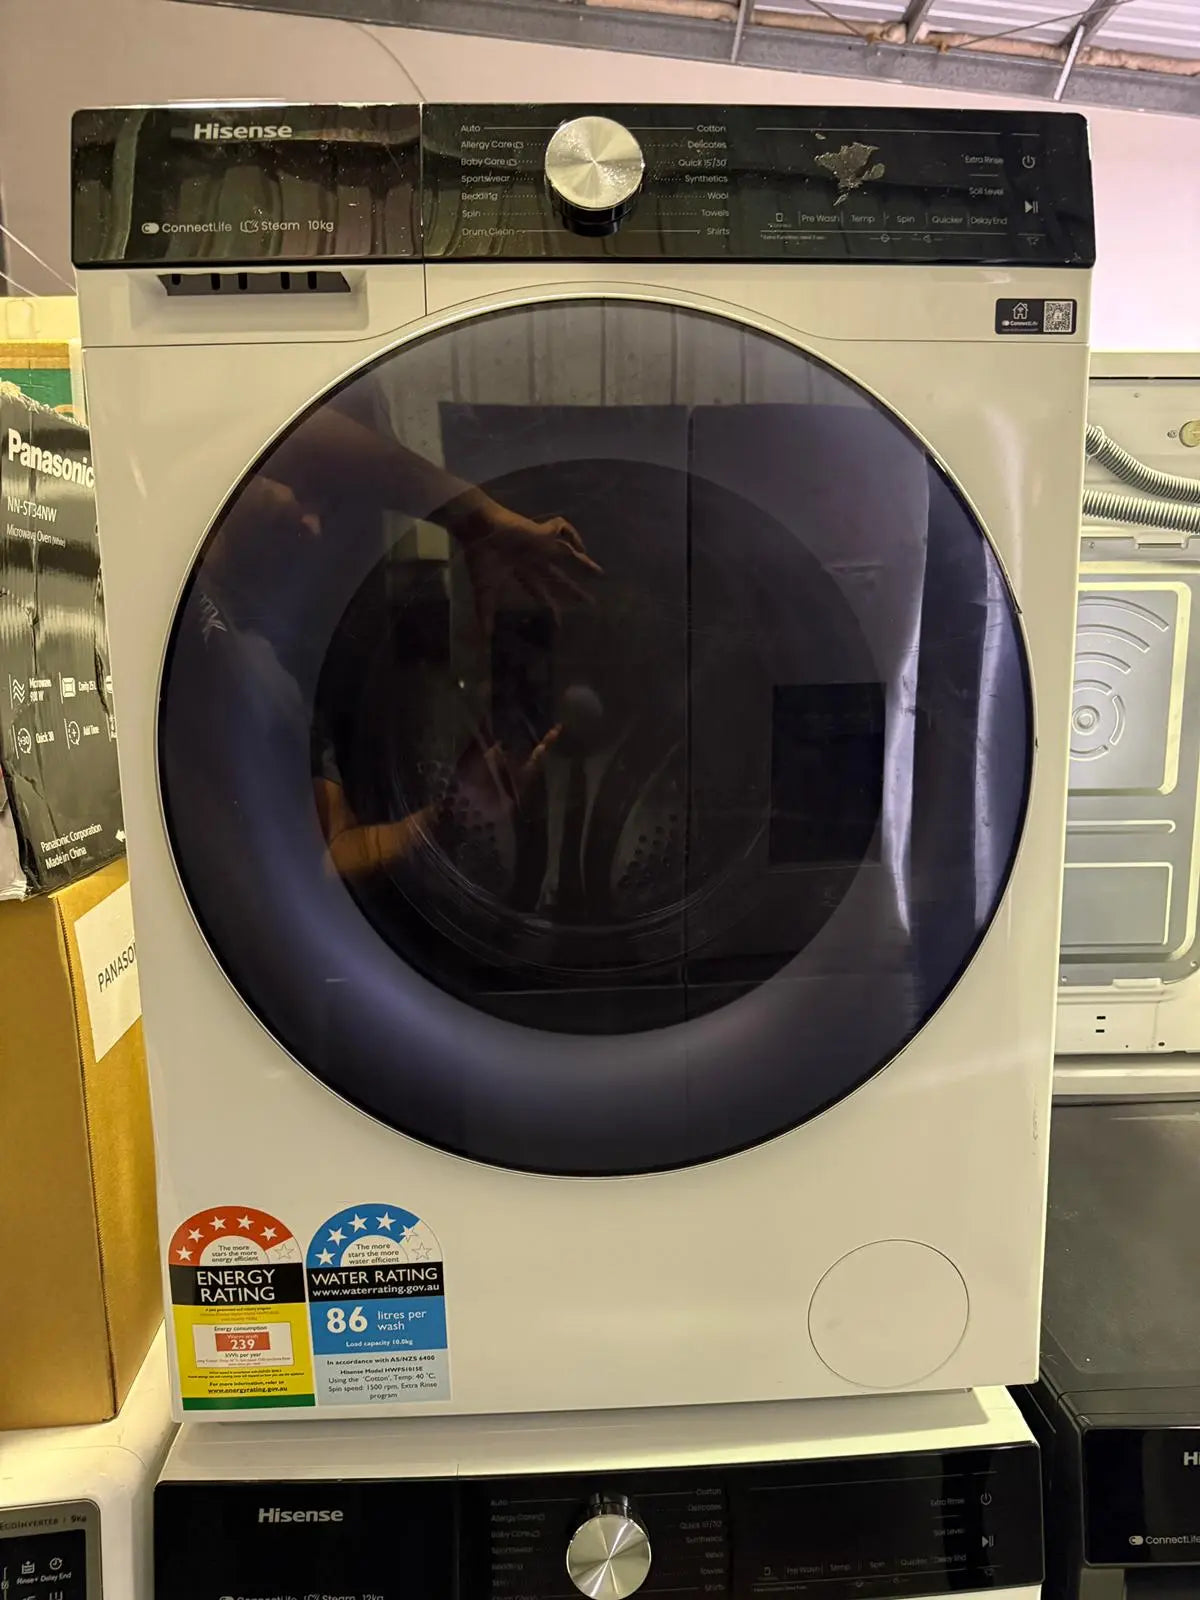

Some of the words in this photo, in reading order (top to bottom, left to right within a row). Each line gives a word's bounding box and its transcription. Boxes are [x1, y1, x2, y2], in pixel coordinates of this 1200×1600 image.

[194, 123, 292, 141] Hisense
[460, 124, 481, 132] Auto
[461, 141, 490, 150] Allergy
[491, 140, 512, 149] Care
[687, 141, 727, 149] Delicates
[461, 158, 482, 167] Baby
[484, 158, 505, 166] Care
[678, 159, 701, 167] Quick
[965, 156, 984, 164] Extra
[461, 175, 510, 184] Sportswear
[685, 174, 728, 184] Synthetics
[969, 187, 982, 195] Soil
[461, 192, 498, 201] Bedding
[707, 192, 729, 200] Wool
[462, 210, 481, 218] Spin
[701, 209, 730, 217] Towels
[801, 214, 815, 222] Pre
[816, 214, 840, 223] Wash
[851, 215, 875, 224] Temp
[896, 216, 915, 224] Spin
[932, 216, 963, 224] Quicker
[970, 217, 992, 226] Delay
[162, 222, 232, 233] ConnectLife
[261, 220, 300, 232] Steam
[308, 220, 334, 232] 10kg
[462, 228, 486, 237] Drum
[488, 228, 514, 236] Clean
[706, 228, 730, 236] Shirts
[8, 428, 95, 488] Panasonic
[7, 496, 58, 522] NN-ST34NW
[36, 530, 52, 544] Oven
[36, 732, 48, 744] Quick
[40, 832, 70, 852] Panasonic
[70, 822, 103, 842] Corporation
[44, 852, 62, 870] Made
[62, 850, 70, 863] in
[69, 845, 88, 860] China
[97, 942, 136, 993] PANASO
[370, 1256, 400, 1264] efficient
[196, 1268, 276, 1286] ENERGY
[311, 1271, 369, 1286] WATER
[375, 1267, 438, 1283] RATING
[200, 1286, 276, 1303] RATING
[312, 1284, 440, 1296] www.waterrating.gov.au
[326, 1306, 368, 1334] 86
[378, 1310, 404, 1320] litres
[408, 1310, 427, 1321] per
[378, 1322, 405, 1331] wash
[230, 1340, 256, 1350] 239
[392, 1338, 413, 1346] 10.0kg
[208, 1386, 288, 1394] www.energyrating.gov.au
[258, 1508, 344, 1523] Hisense
[1145, 1535, 1200, 1544] ConnectLife
